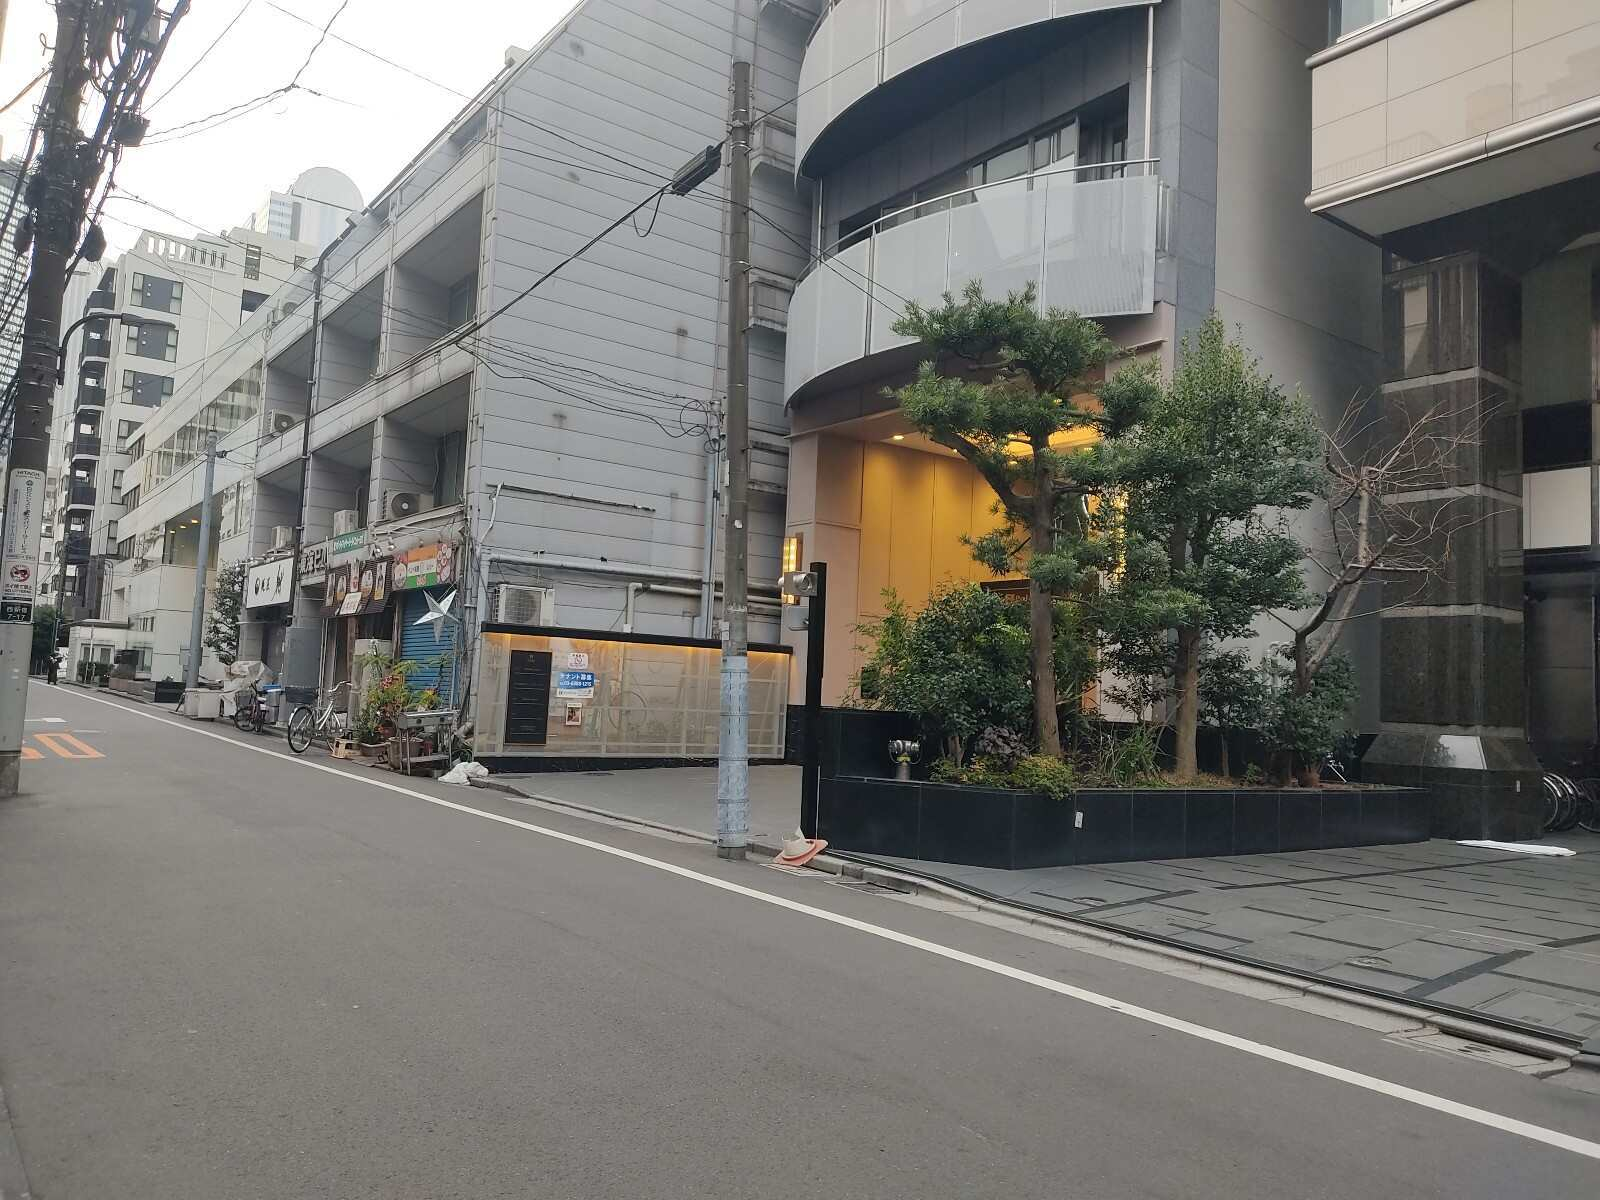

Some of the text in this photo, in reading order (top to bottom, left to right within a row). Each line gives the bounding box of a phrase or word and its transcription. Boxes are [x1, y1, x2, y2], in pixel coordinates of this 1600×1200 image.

[559, 672, 592, 681] テナント募集
